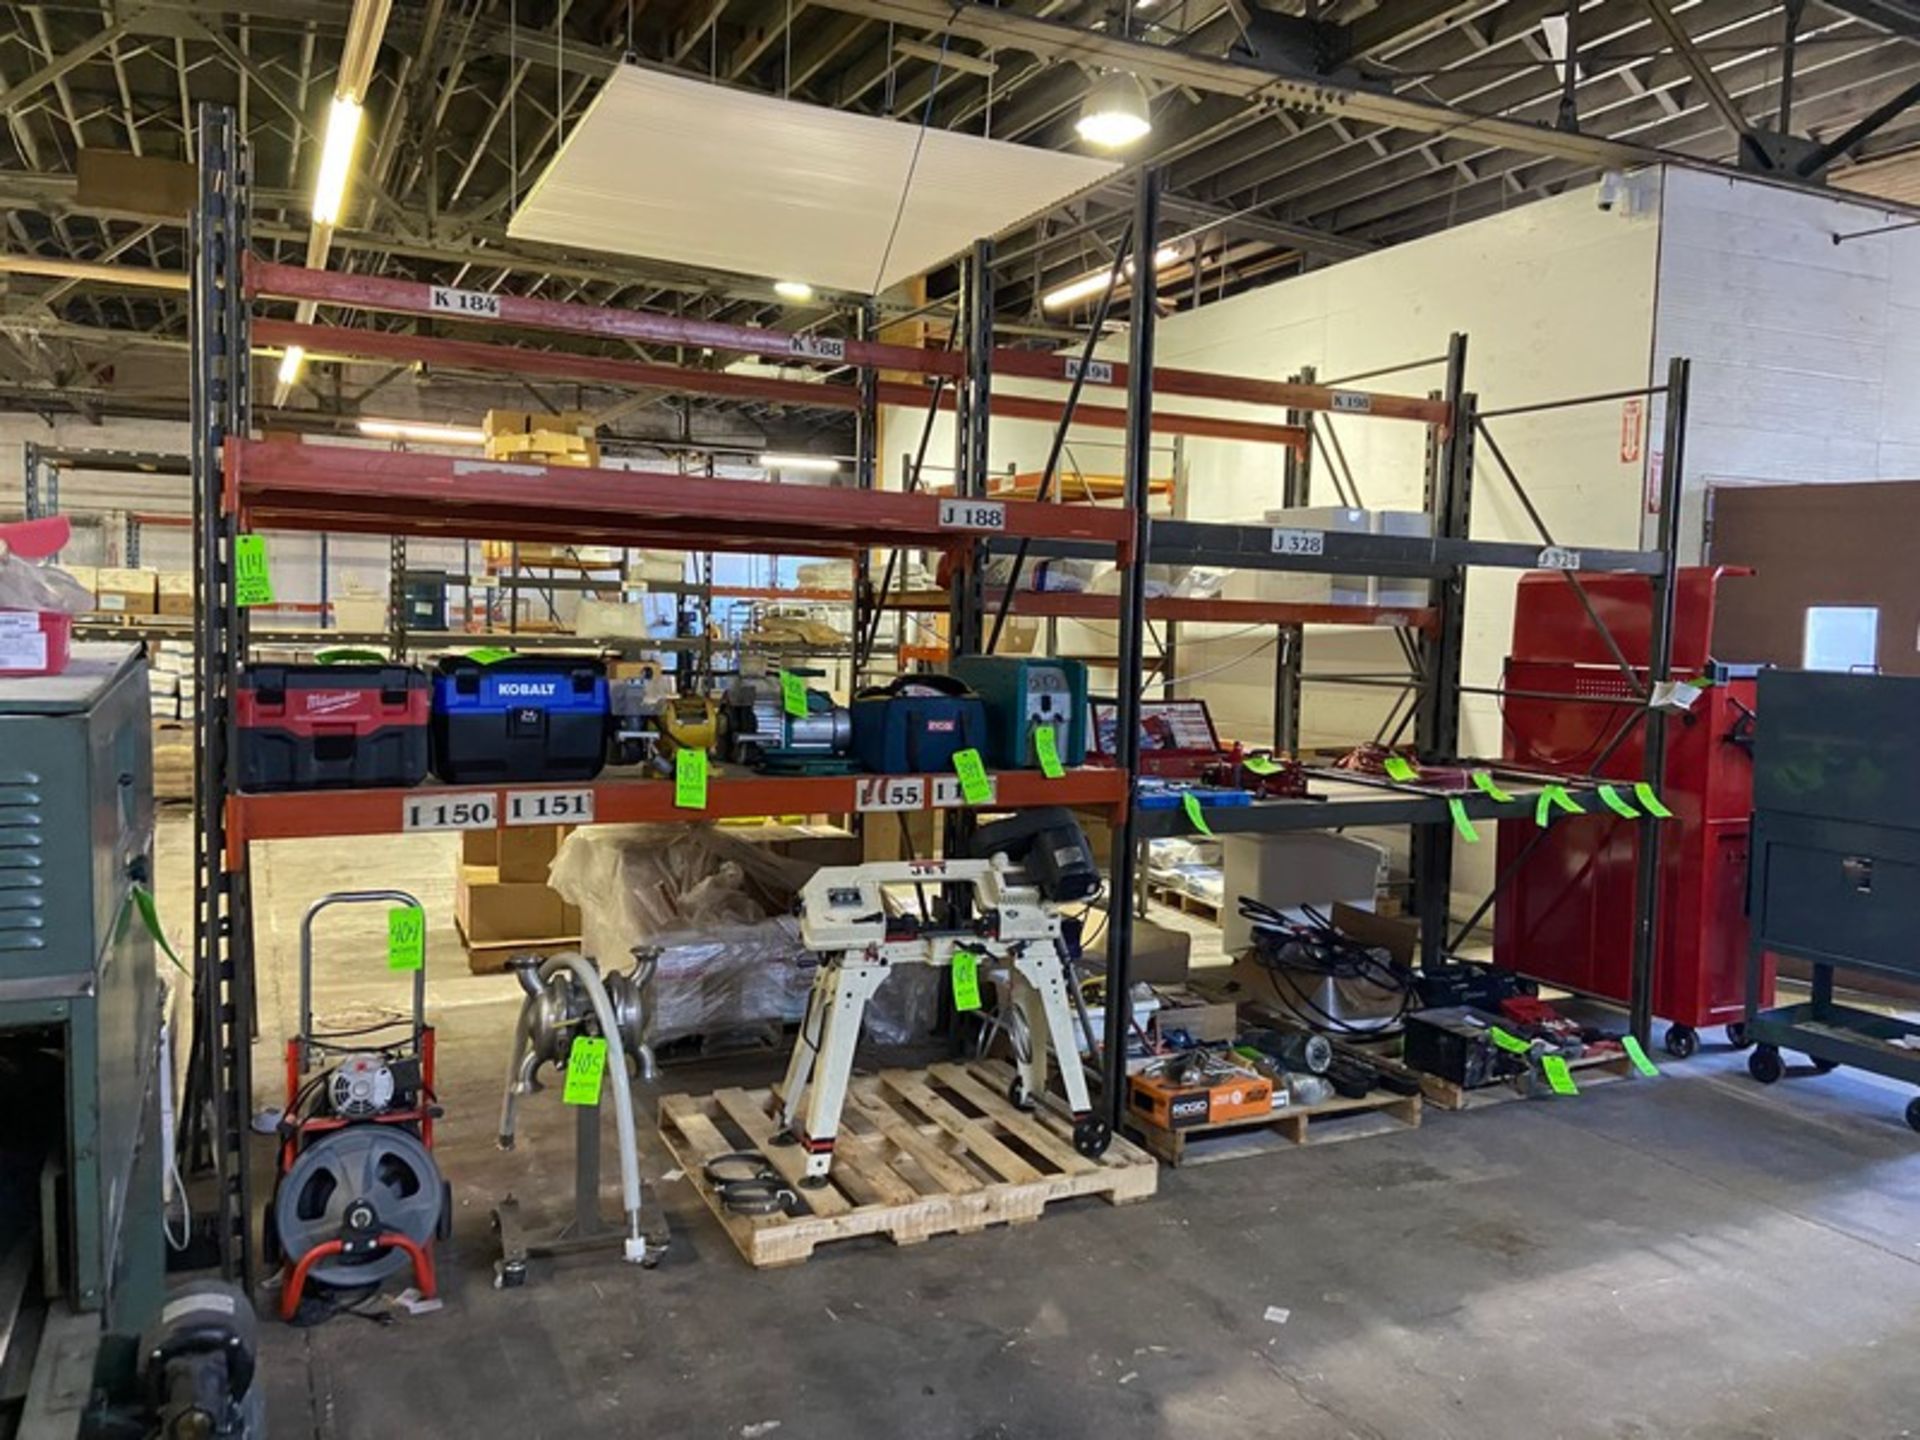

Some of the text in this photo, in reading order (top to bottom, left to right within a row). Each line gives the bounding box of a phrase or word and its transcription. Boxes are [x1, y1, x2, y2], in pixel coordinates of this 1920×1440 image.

[434, 290, 498, 313] K 184
[943, 507, 1001, 527] J 188
[1274, 535, 1321, 553] J 328
[498, 683, 556, 696] KOBALT
[433, 802, 491, 824] 150
[535, 795, 587, 816] 151
